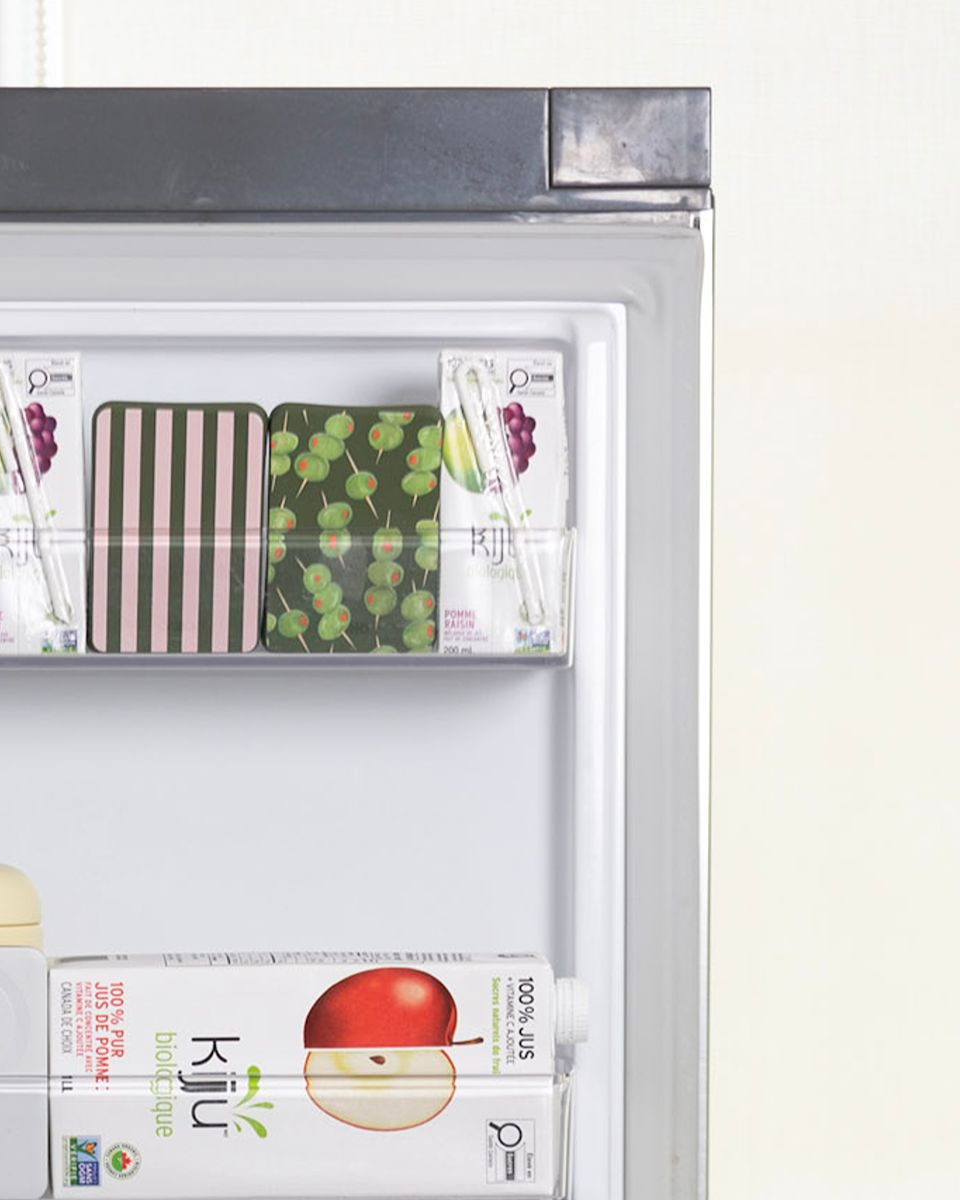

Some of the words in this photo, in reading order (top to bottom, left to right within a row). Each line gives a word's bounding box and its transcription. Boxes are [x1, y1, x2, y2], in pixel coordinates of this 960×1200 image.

[444, 620, 474, 629] RAISIN
[60, 981, 72, 1014] CANADA
[94, 982, 109, 1010] JUS
[518, 976, 535, 1024] 100%
[60, 1016, 72, 1028] DE
[94, 1014, 109, 1032] DE
[60, 1028, 72, 1054] CHOIX
[110, 1029, 124, 1058] PUR
[518, 1026, 535, 1060] JUS
[150, 1032, 177, 1137] biologique
[78, 1164, 86, 1184] OGM
